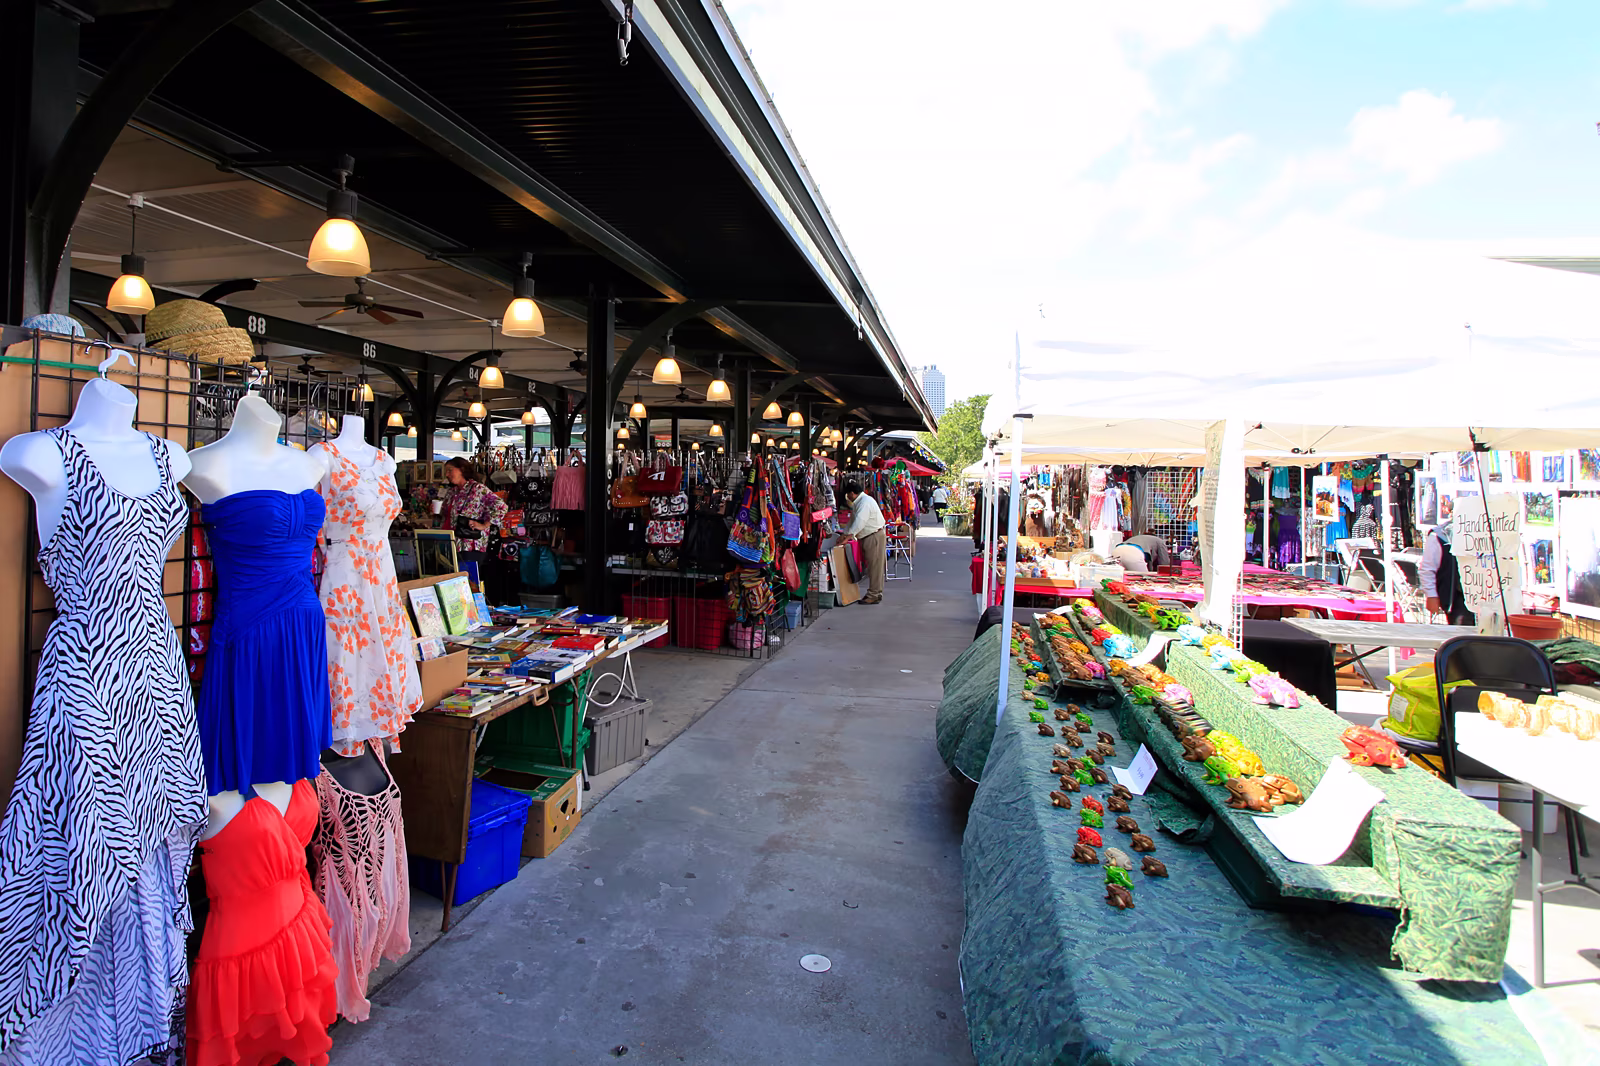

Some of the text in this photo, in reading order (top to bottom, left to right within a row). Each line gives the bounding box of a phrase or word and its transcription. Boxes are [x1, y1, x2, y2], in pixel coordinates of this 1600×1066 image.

[248, 315, 266, 335] 88
[363, 342, 377, 359] 86
[469, 367, 479, 381] 84
[528, 381, 536, 394] 82
[1457, 513, 1482, 534] Hand
[1463, 565, 1484, 594] Buy
[1485, 568, 1494, 589] 3
